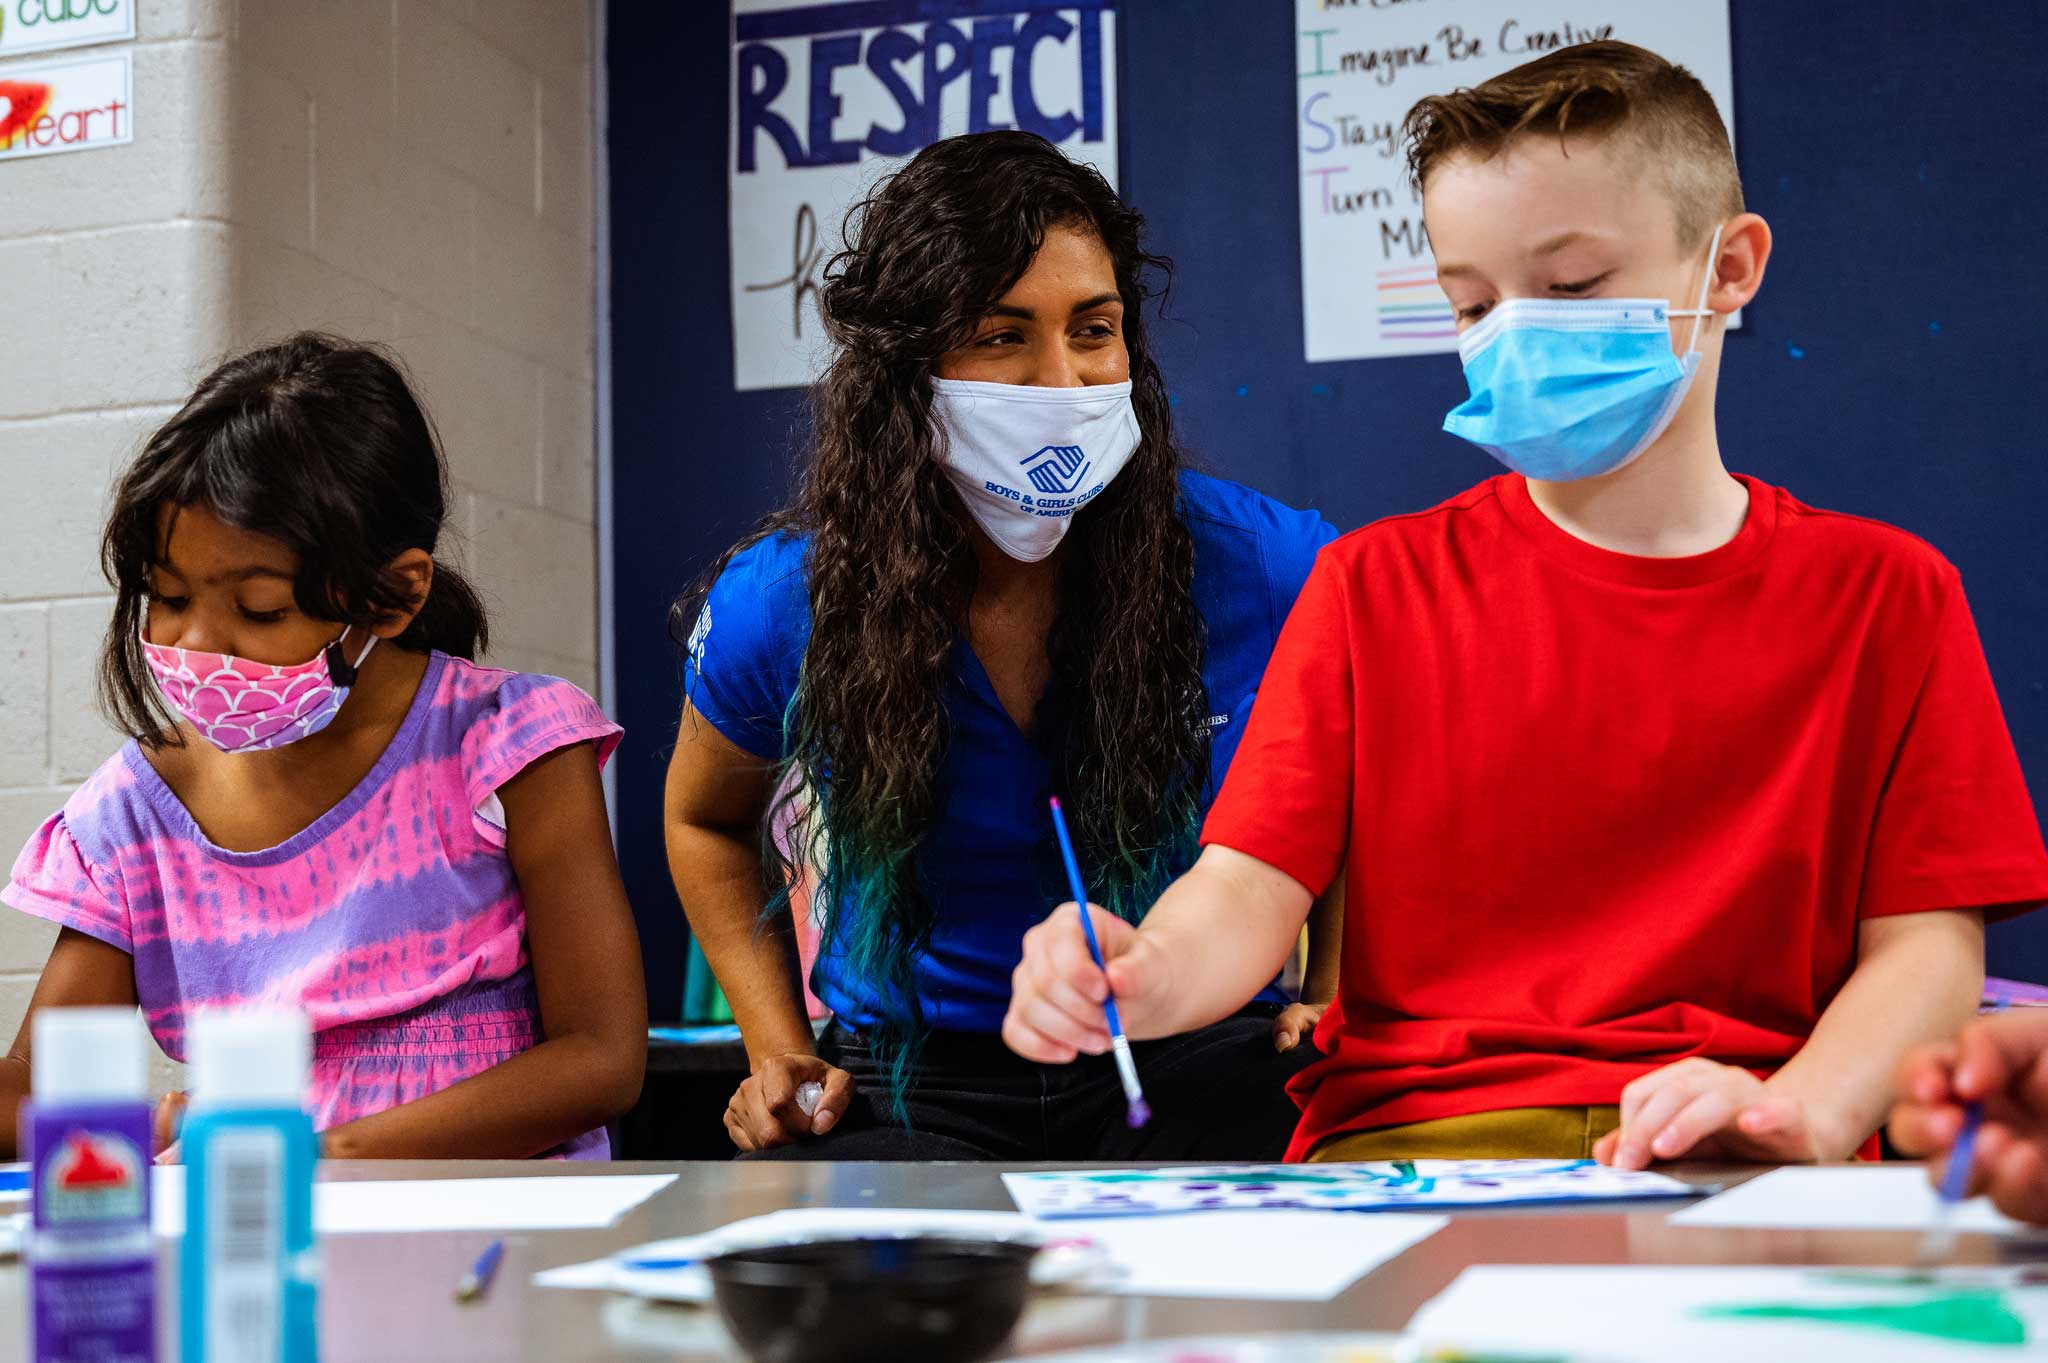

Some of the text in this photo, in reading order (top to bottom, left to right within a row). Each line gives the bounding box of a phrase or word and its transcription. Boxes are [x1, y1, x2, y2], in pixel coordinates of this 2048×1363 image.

[1436, 24, 1486, 60] Be
[1306, 166, 1393, 216] Turn
[985, 481, 1104, 507] BOYS & GIRLS CLUBS
[1020, 505, 1034, 513] OF
